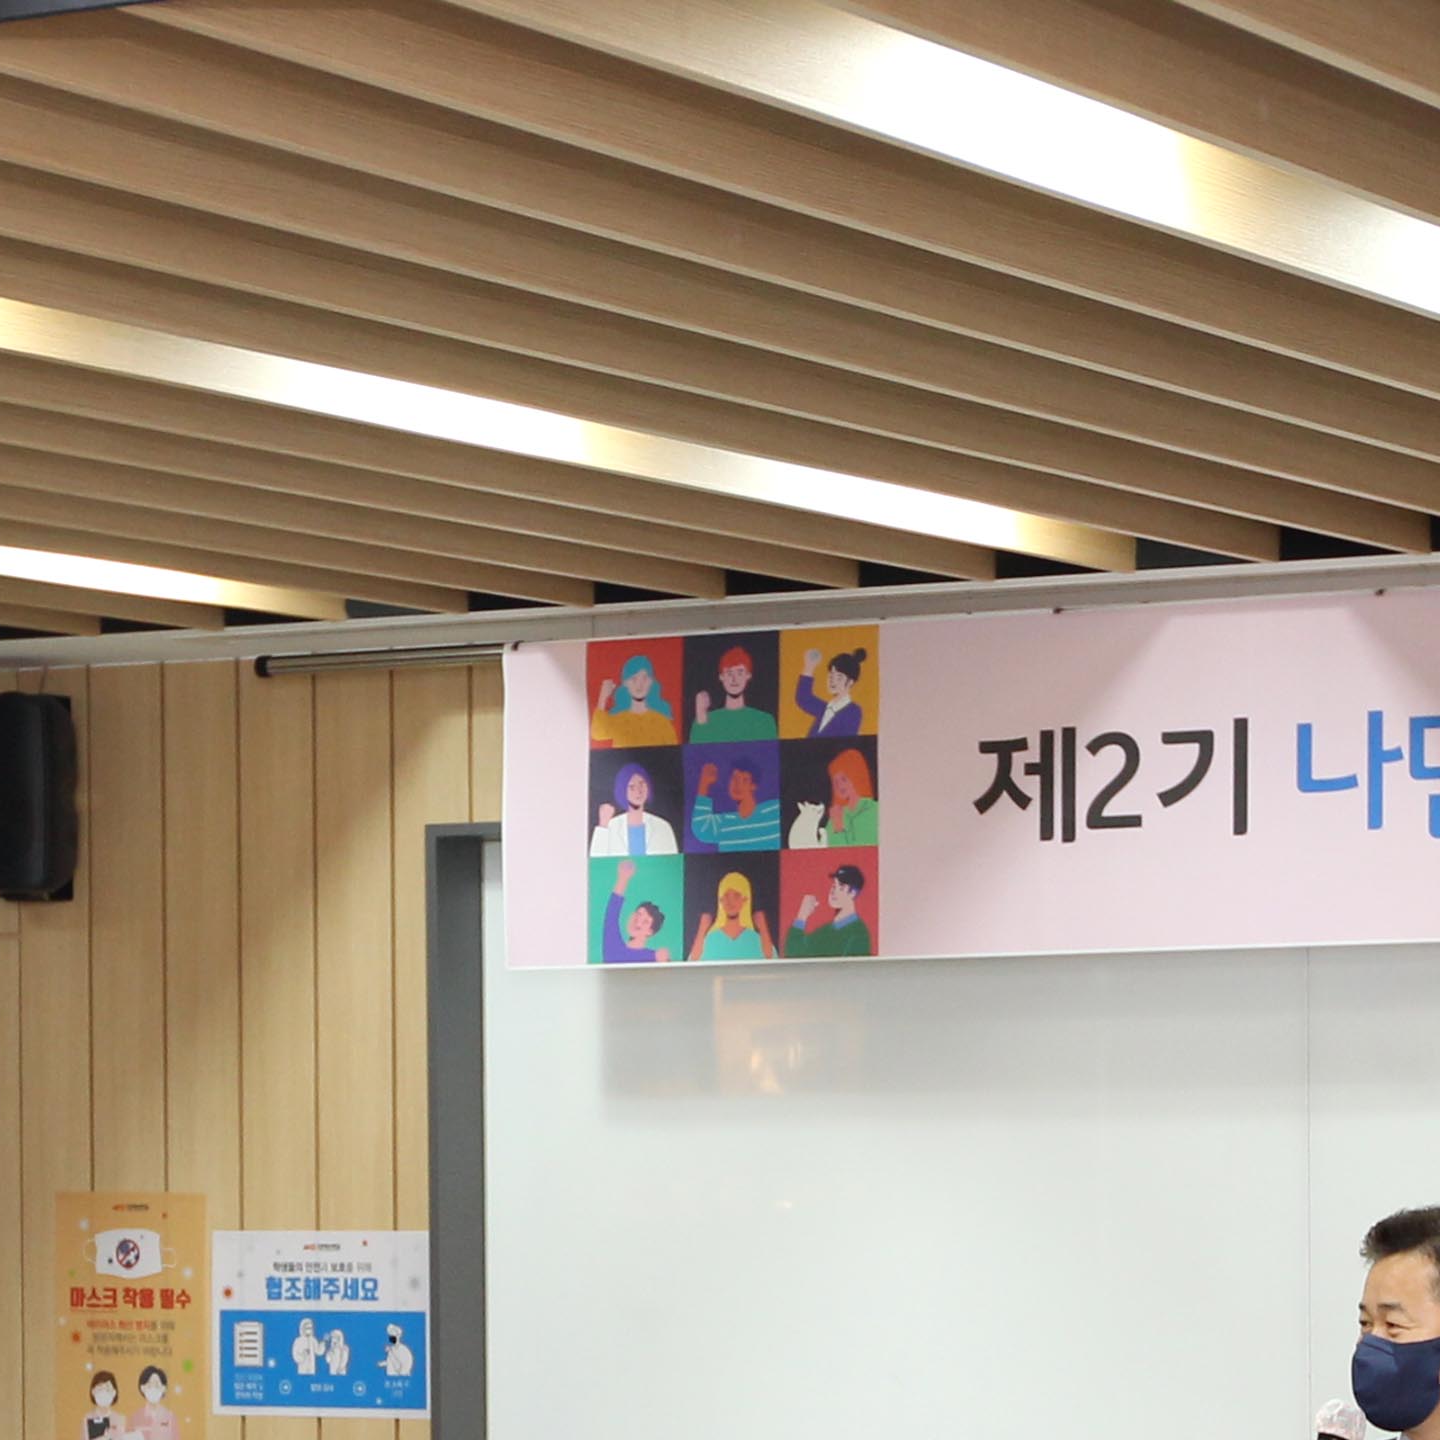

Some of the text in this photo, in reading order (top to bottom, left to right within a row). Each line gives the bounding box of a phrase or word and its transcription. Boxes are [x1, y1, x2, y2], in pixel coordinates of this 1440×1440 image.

[973, 717, 1248, 842] 제2기
[70, 1287, 191, 1309] 마스크 착용 필수
[266, 1276, 379, 1301] 협조해주세요
